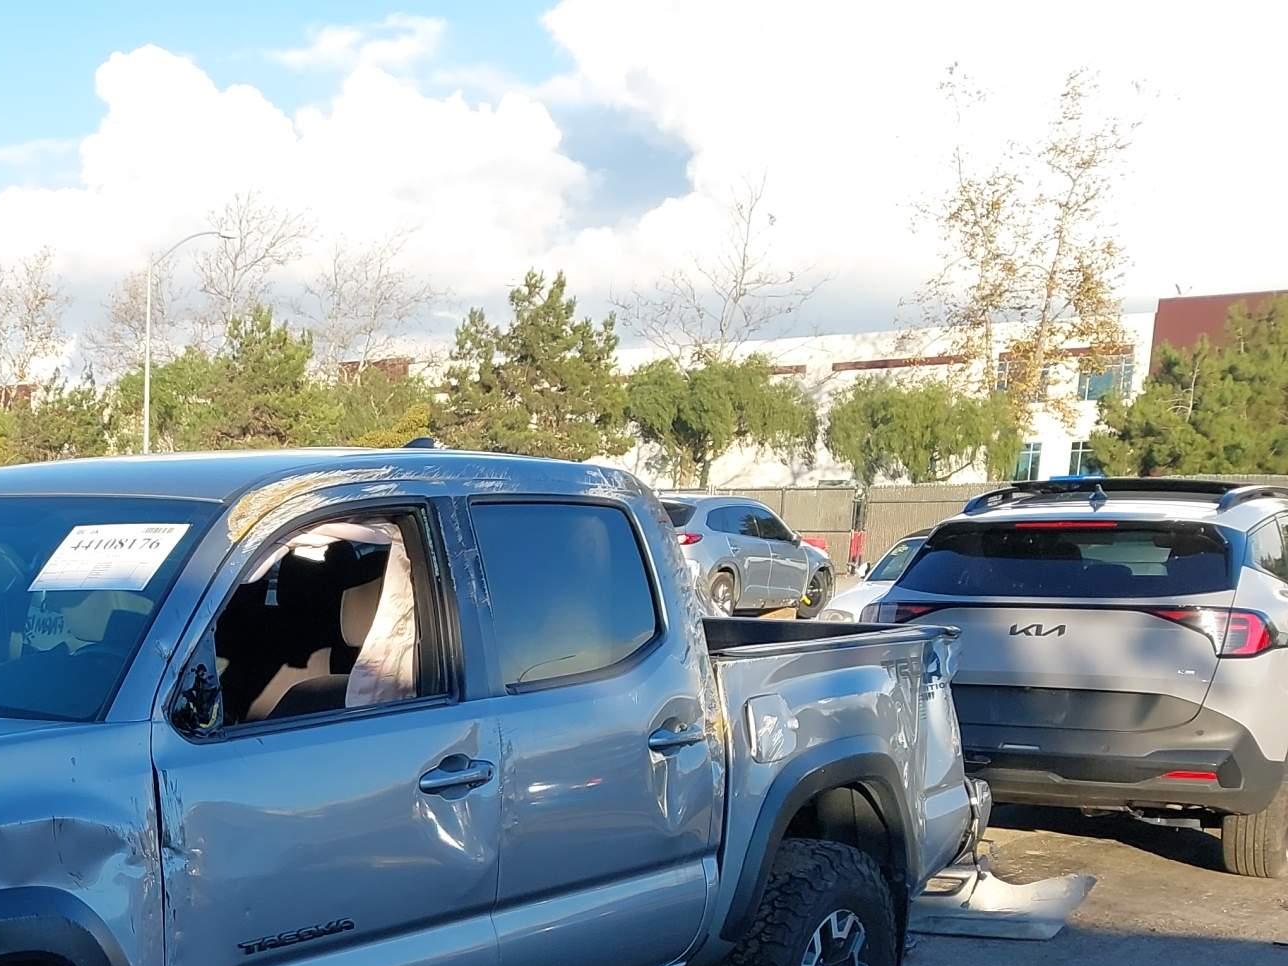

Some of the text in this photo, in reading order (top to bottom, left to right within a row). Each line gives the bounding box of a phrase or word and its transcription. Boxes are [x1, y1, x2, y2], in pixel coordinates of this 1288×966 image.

[70, 537, 161, 552] 44108176
[1009, 623, 1067, 637] KIA
[237, 917, 355, 955] TACOMA
